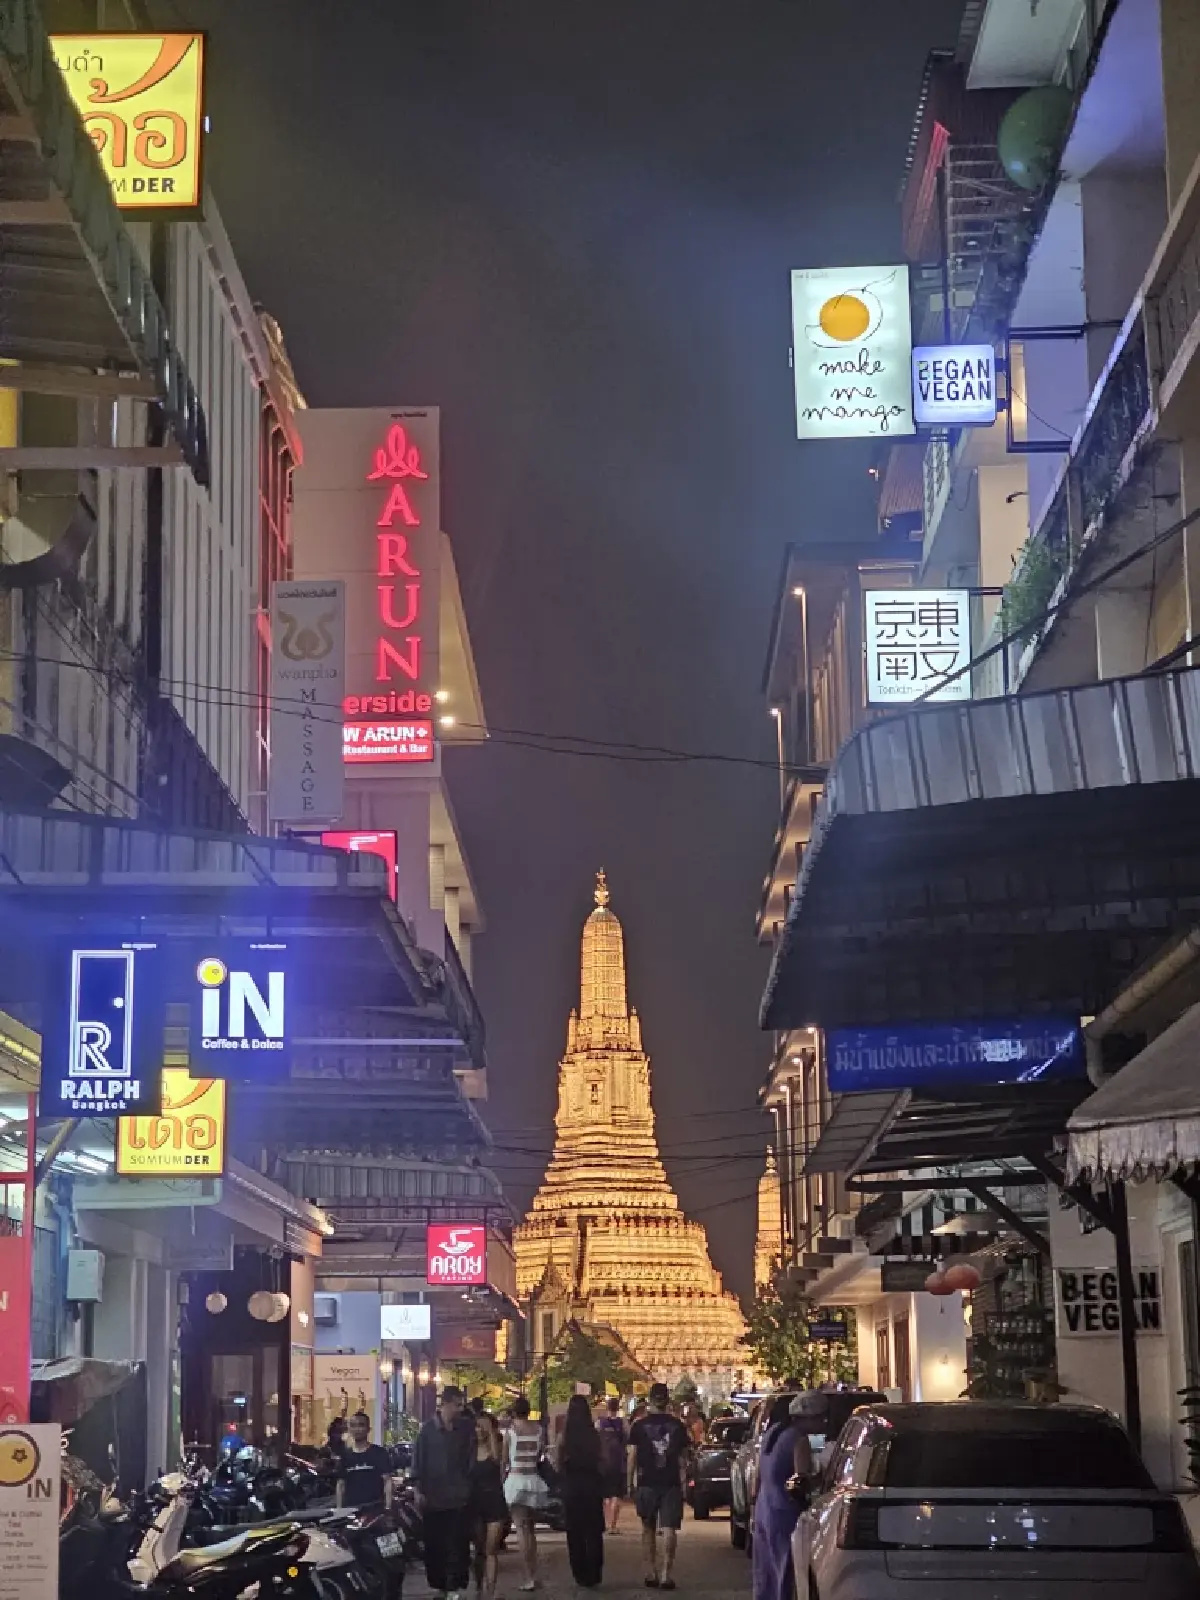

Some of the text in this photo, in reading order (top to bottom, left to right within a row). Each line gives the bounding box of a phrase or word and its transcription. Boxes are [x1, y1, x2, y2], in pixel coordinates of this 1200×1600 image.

[132, 177, 175, 193] DER
[819, 348, 885, 376] make
[830, 387, 877, 401] me
[918, 380, 992, 402] VEGAN
[802, 404, 906, 432] mango
[376, 483, 422, 682] ARUN
[300, 688, 318, 812] MASSAGE
[61, 1080, 140, 1099] RALPH
[72, 1099, 127, 1112] Bangkok
[1060, 1271, 1157, 1302] BEGN
[1063, 1301, 1161, 1332] VEGN
